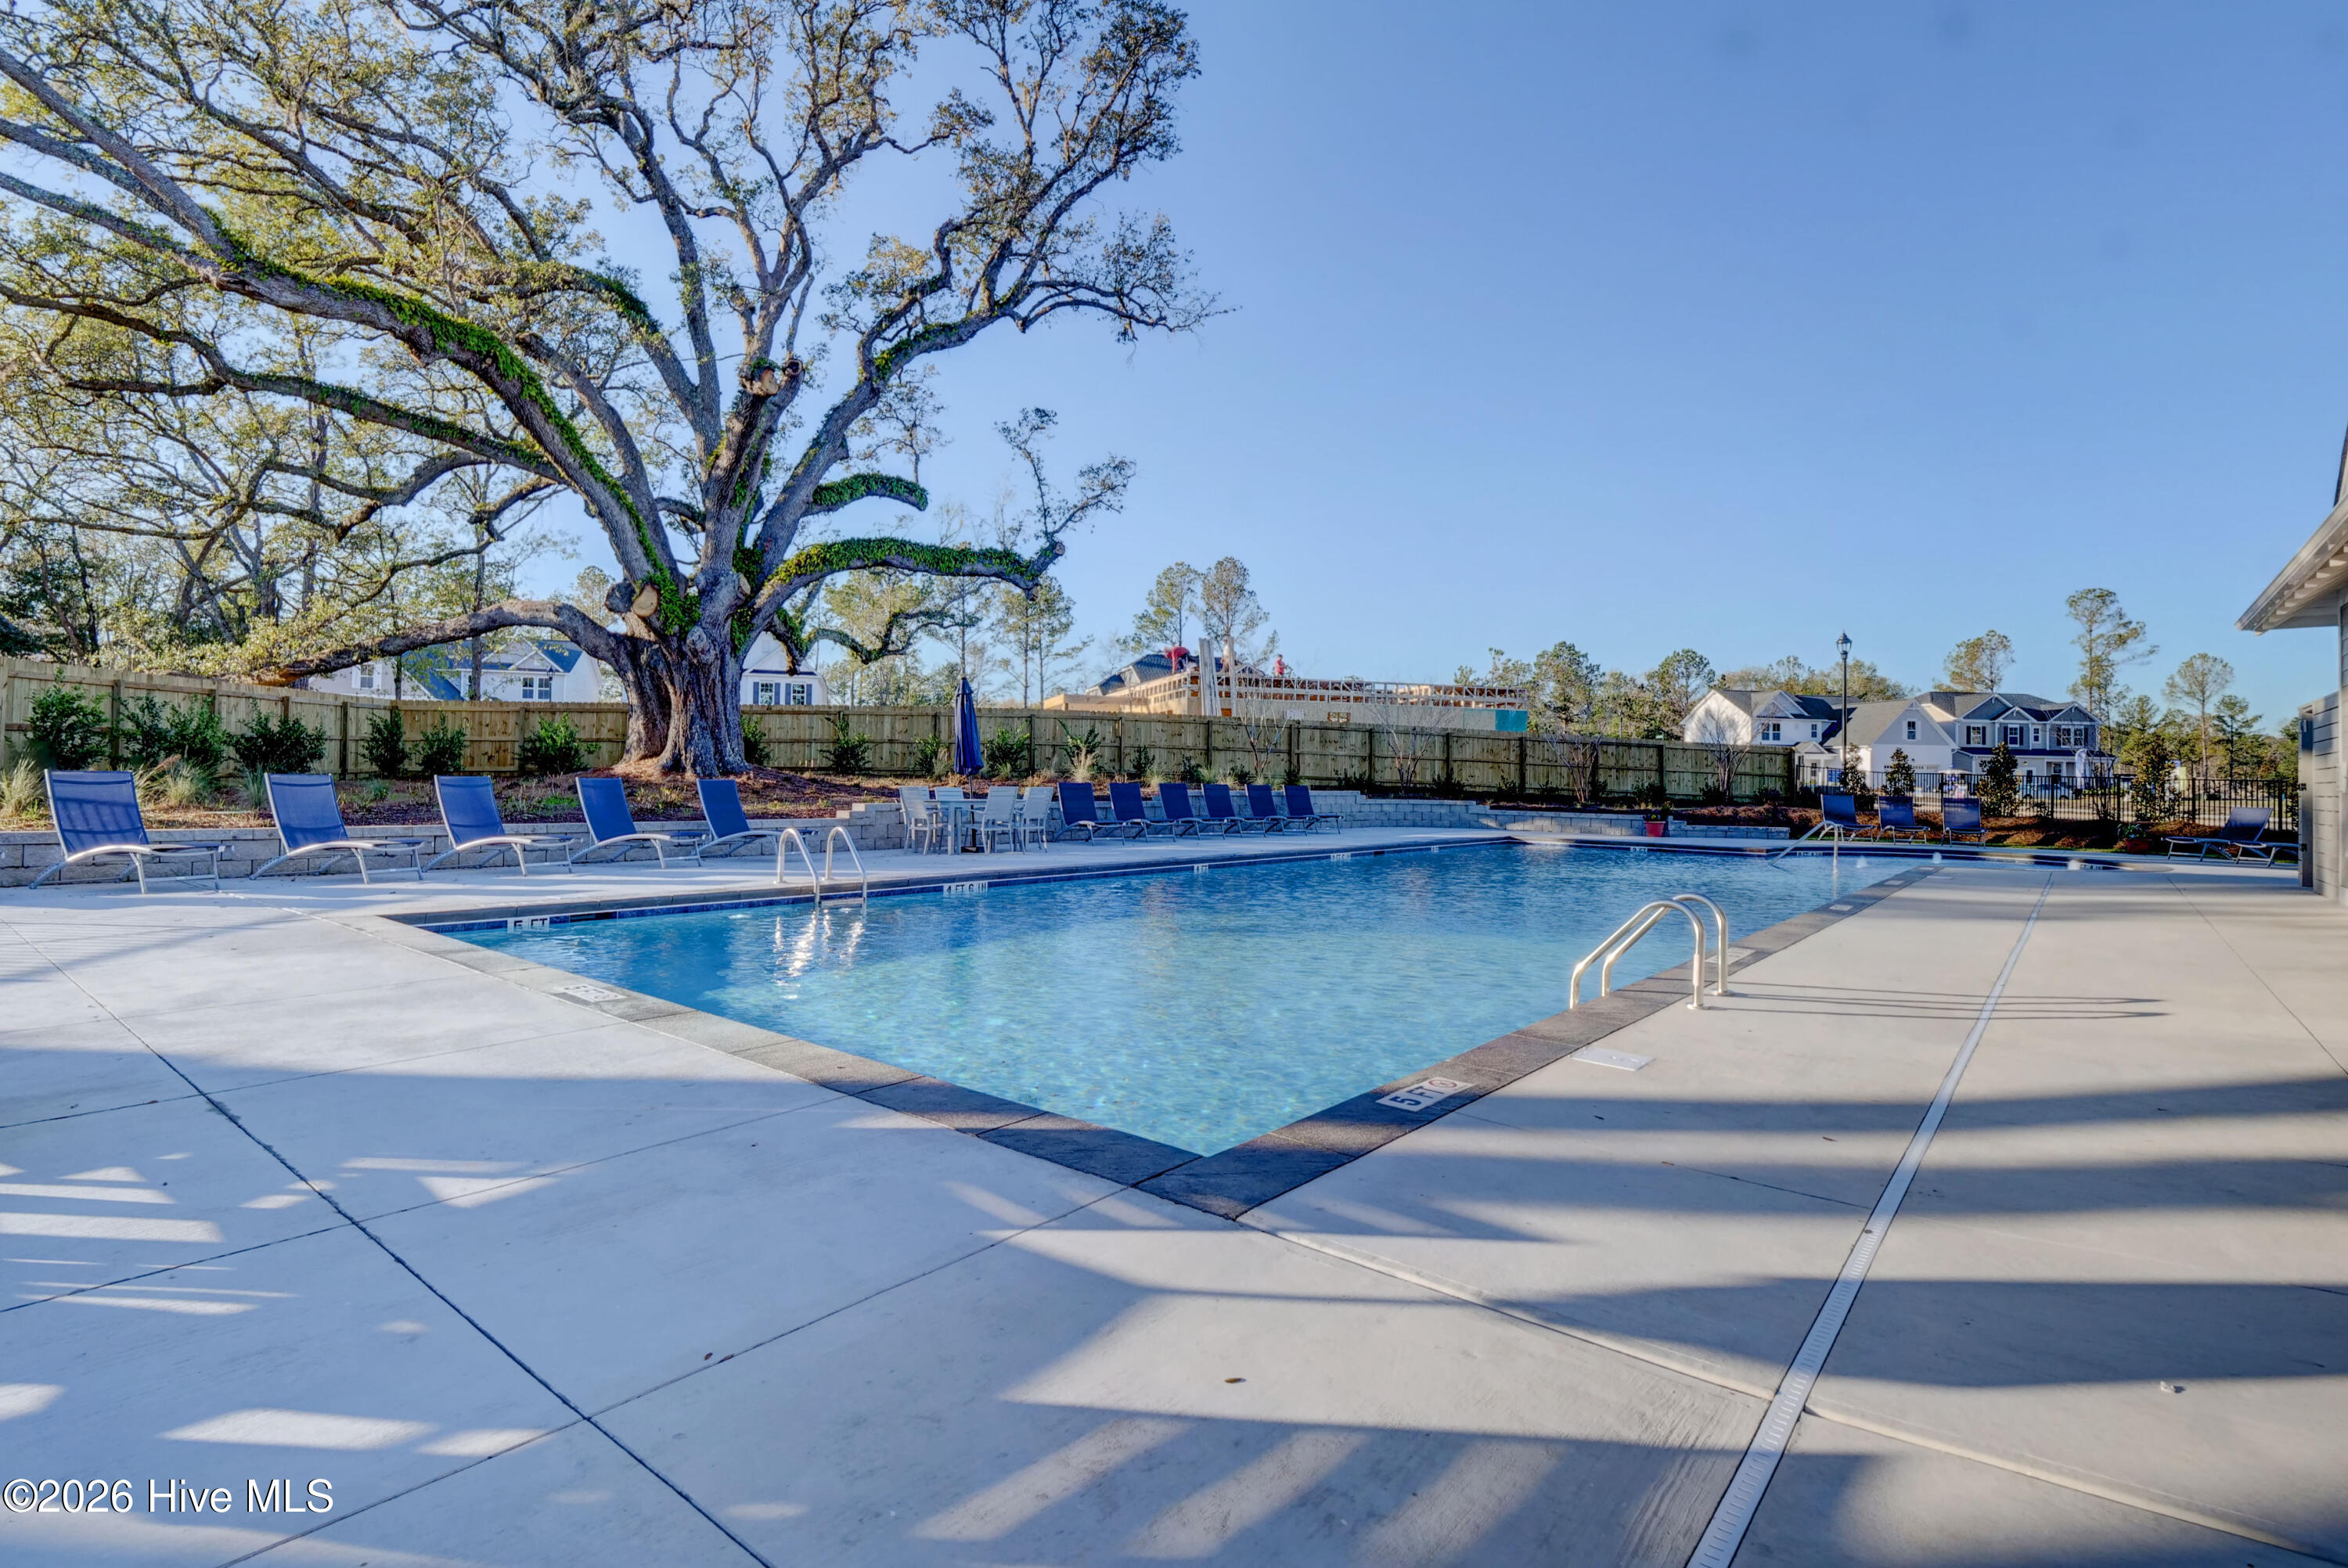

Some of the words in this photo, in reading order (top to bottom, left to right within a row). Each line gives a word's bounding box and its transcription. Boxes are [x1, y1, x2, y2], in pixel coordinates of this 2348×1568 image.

[955, 884, 965, 893] FT
[978, 882, 986, 891] IN
[1388, 1096, 1422, 1106] 5
[1406, 1086, 1445, 1099] FT
